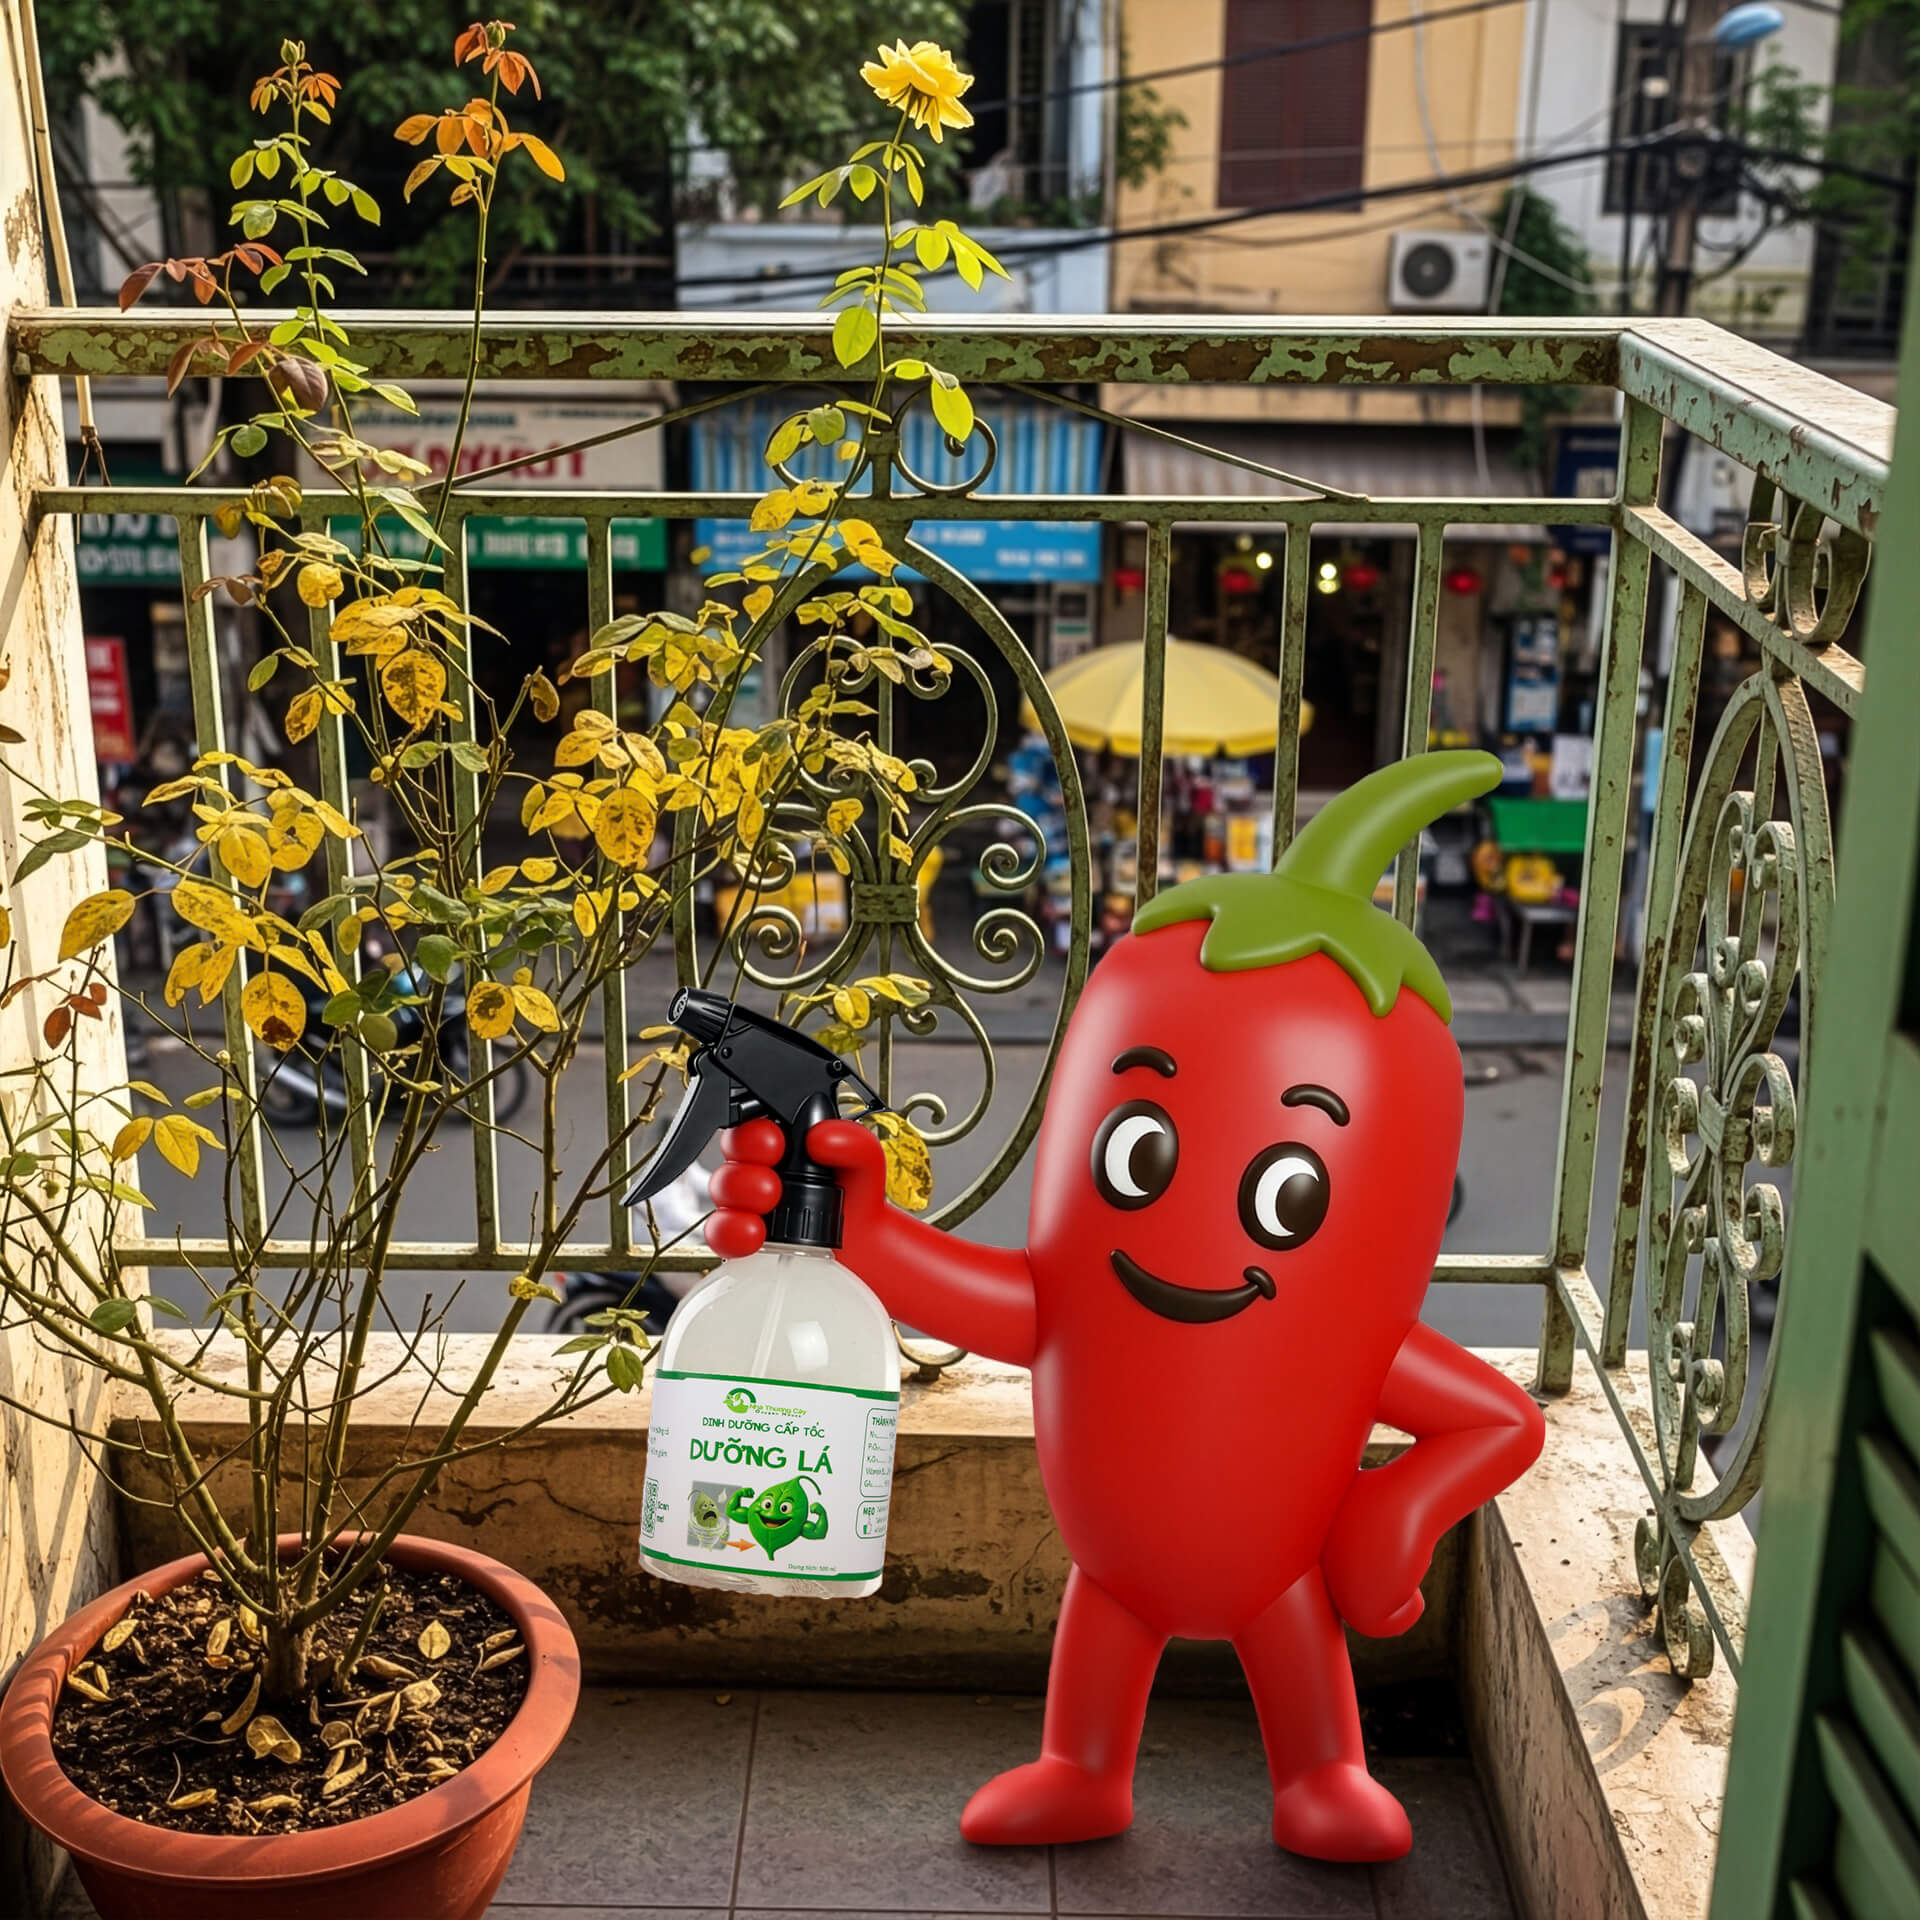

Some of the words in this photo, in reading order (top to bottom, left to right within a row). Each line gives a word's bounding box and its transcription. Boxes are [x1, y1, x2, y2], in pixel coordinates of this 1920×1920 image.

[702, 1417, 725, 1428] DINH
[728, 1419, 771, 1433] DƯỠNG
[774, 1421, 800, 1435] CẤP
[803, 1421, 825, 1438] TỐC
[690, 1437, 787, 1469] DƯỠNG
[797, 1445, 833, 1474] LÁ
